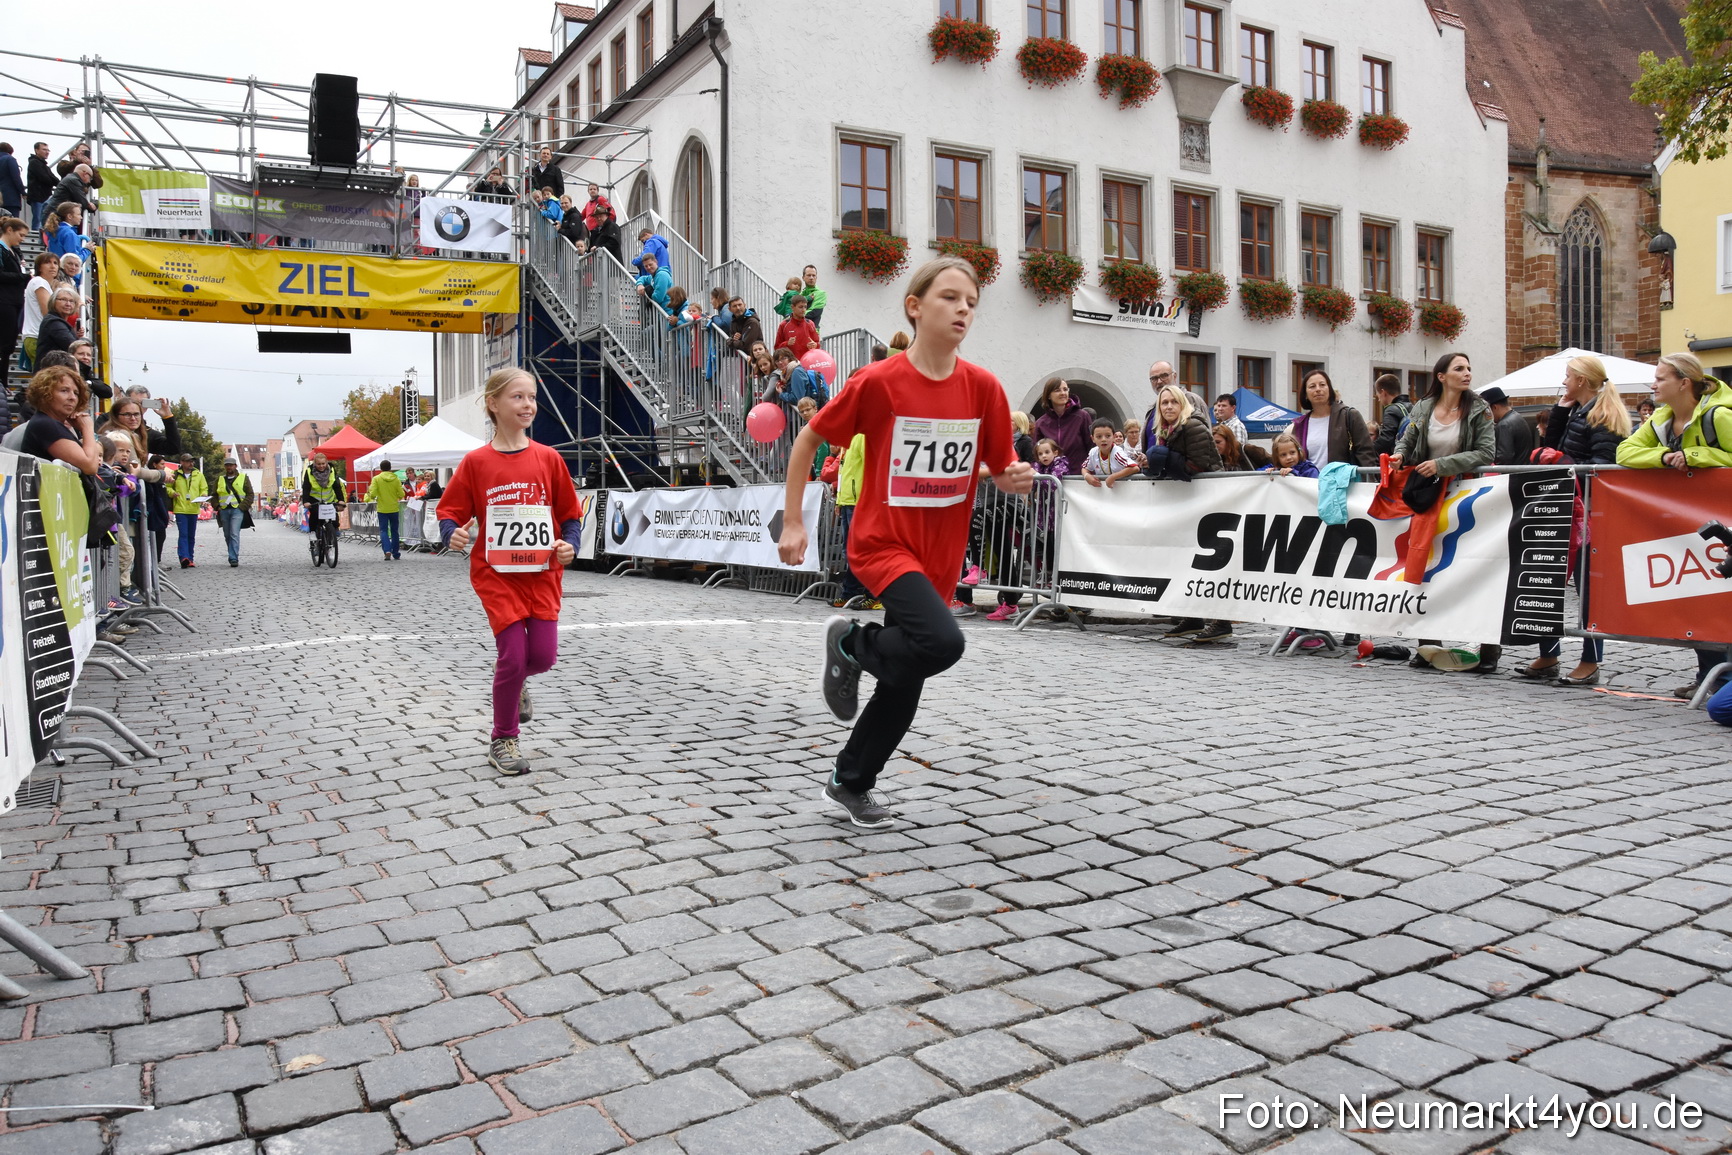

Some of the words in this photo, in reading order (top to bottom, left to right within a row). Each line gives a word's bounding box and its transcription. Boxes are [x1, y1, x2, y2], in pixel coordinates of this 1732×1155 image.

[216, 193, 284, 212] BOCK
[291, 202, 324, 211] OFFICE
[325, 205, 370, 216] INDUSTRY
[156, 208, 203, 217] NeuerMarkt
[437, 206, 468, 220] BMW
[309, 216, 391, 230] www.bockonline.de
[130, 268, 183, 280] Neumarkter
[185, 273, 226, 284] Stadtlauf
[278, 262, 370, 297] ZIEL
[418, 287, 463, 296] Neumarkter
[464, 288, 500, 297] Stadtlauf
[132, 296, 179, 305] Neumarkter
[180, 299, 218, 308] Stadtlauf
[389, 309, 431, 317] Neumarkter
[432, 311, 464, 319] Stadtlauf
[1116, 314, 1148, 325] stadtwerke
[1148, 316, 1176, 327] neumarkt
[938, 423, 976, 433] BOCK
[903, 440, 973, 474] 7182
[486, 482, 529, 497] Neumarkter
[1538, 483, 1559, 492] Strom
[487, 491, 521, 506] Stadtlauf
[519, 508, 546, 516] BOCK
[1534, 506, 1559, 514] Erdgas
[494, 521, 550, 546] 7236
[1534, 529, 1557, 537] Wasser
[1190, 512, 1378, 580] swn
[511, 553, 536, 563] Heidi
[1532, 553, 1554, 561] Wärme
[1060, 578, 1097, 591] Leistungen,
[1098, 580, 1111, 591] die
[1112, 583, 1157, 595] verbinden
[1529, 576, 1553, 585] Freizeit
[1184, 576, 1303, 606] stadtwerke
[1309, 587, 1428, 616] neumarkt
[1519, 599, 1555, 609] Stadtbusse
[1515, 623, 1554, 632] Parkhäuser
[32, 634, 57, 650] Freizeit
[36, 671, 71, 690] Stadtbusse
